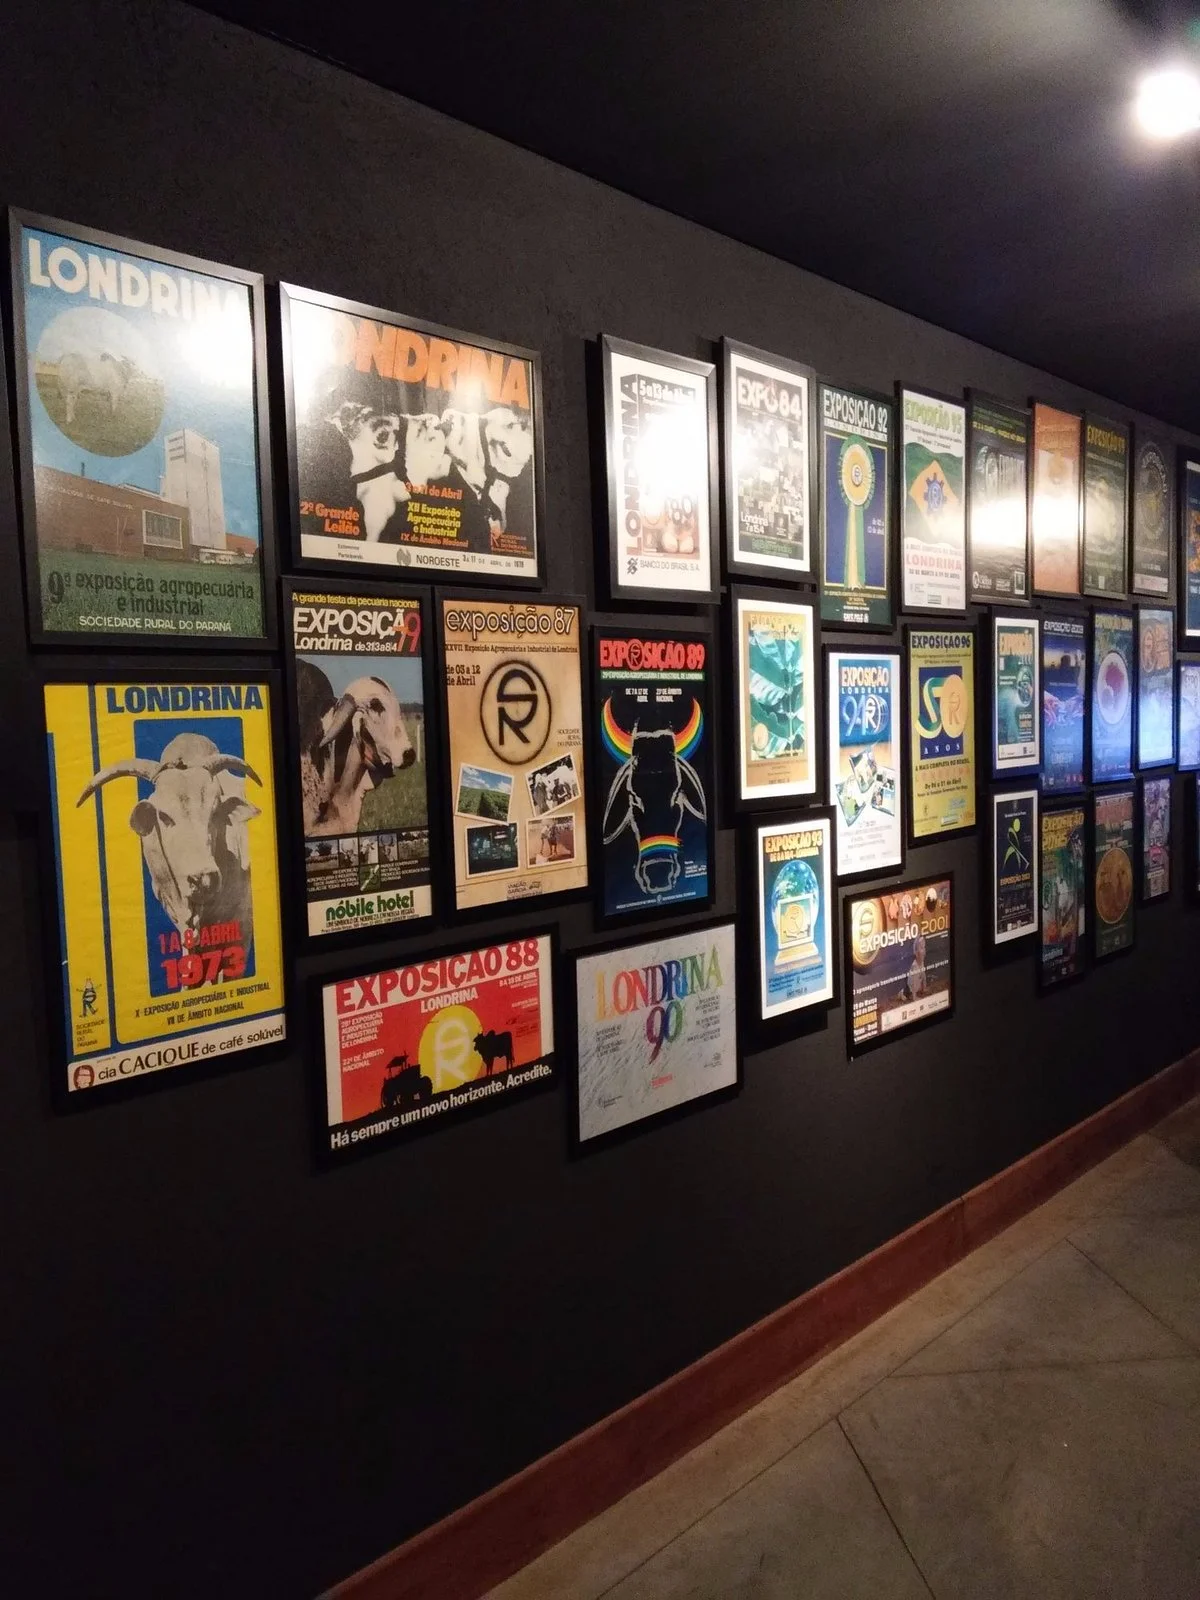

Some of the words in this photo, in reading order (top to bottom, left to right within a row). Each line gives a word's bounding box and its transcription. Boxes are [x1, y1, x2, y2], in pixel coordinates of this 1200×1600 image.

[330, 314, 530, 410] ONDRINA
[878, 406, 887, 432] 92
[441, 487, 463, 500] Abril
[315, 503, 359, 521] Grande
[407, 512, 461, 528] Agropecuária
[421, 503, 461, 518] Exposição
[324, 519, 360, 535] Leilão
[420, 525, 457, 538] Industrial
[416, 554, 460, 568] NOROESTE
[76, 571, 155, 594] exposição
[160, 577, 254, 599] agropecuária
[292, 592, 298, 601] A
[299, 594, 326, 604] grande
[327, 595, 346, 604] festa
[118, 598, 127, 611] e
[131, 595, 204, 615] industrial
[79, 616, 142, 628] SOCIEDADE
[145, 618, 176, 630] RURAL
[179, 620, 193, 629] DO
[445, 605, 551, 641] exposição
[553, 606, 576, 635] 87
[295, 632, 352, 651] Londrina
[472, 664, 480, 675] 12
[687, 644, 705, 670] 89
[456, 676, 475, 686] Abril
[841, 666, 889, 687] EXPOSIÇÃO
[106, 687, 263, 713] LONDRINA
[326, 898, 374, 921] nóbile
[377, 890, 414, 912] hotel
[160, 934, 166, 953] 1
[169, 933, 181, 953] A
[200, 921, 243, 946] ABRIL
[860, 924, 918, 953] EXPOSIÇÃO
[506, 938, 539, 971] 88
[161, 947, 246, 989] 1973
[596, 944, 723, 1022] LONDRINA
[144, 1001, 179, 1016] EXPOSIÇÃO
[181, 991, 226, 1008] AGROPECUÁRIA
[230, 989, 234, 997] E
[237, 982, 270, 997] INDUSTRIAL
[176, 1014, 185, 1023] DE
[188, 1007, 212, 1021] ÂMBITO
[214, 1001, 244, 1014] NACIONAL
[420, 987, 479, 1014] LONDRINA
[645, 999, 684, 1065] 90
[98, 1068, 116, 1080] cia
[119, 1042, 199, 1075] CACIQUE
[202, 1043, 216, 1055] de
[219, 1035, 243, 1050] café
[247, 1025, 283, 1044] solúvel
[331, 1130, 349, 1149] Há
[350, 1117, 400, 1143] sempre
[401, 1108, 420, 1125] um
[421, 1097, 449, 1118] novo
[450, 1080, 504, 1108] horizonte.
[506, 1063, 552, 1087] Acredite.
